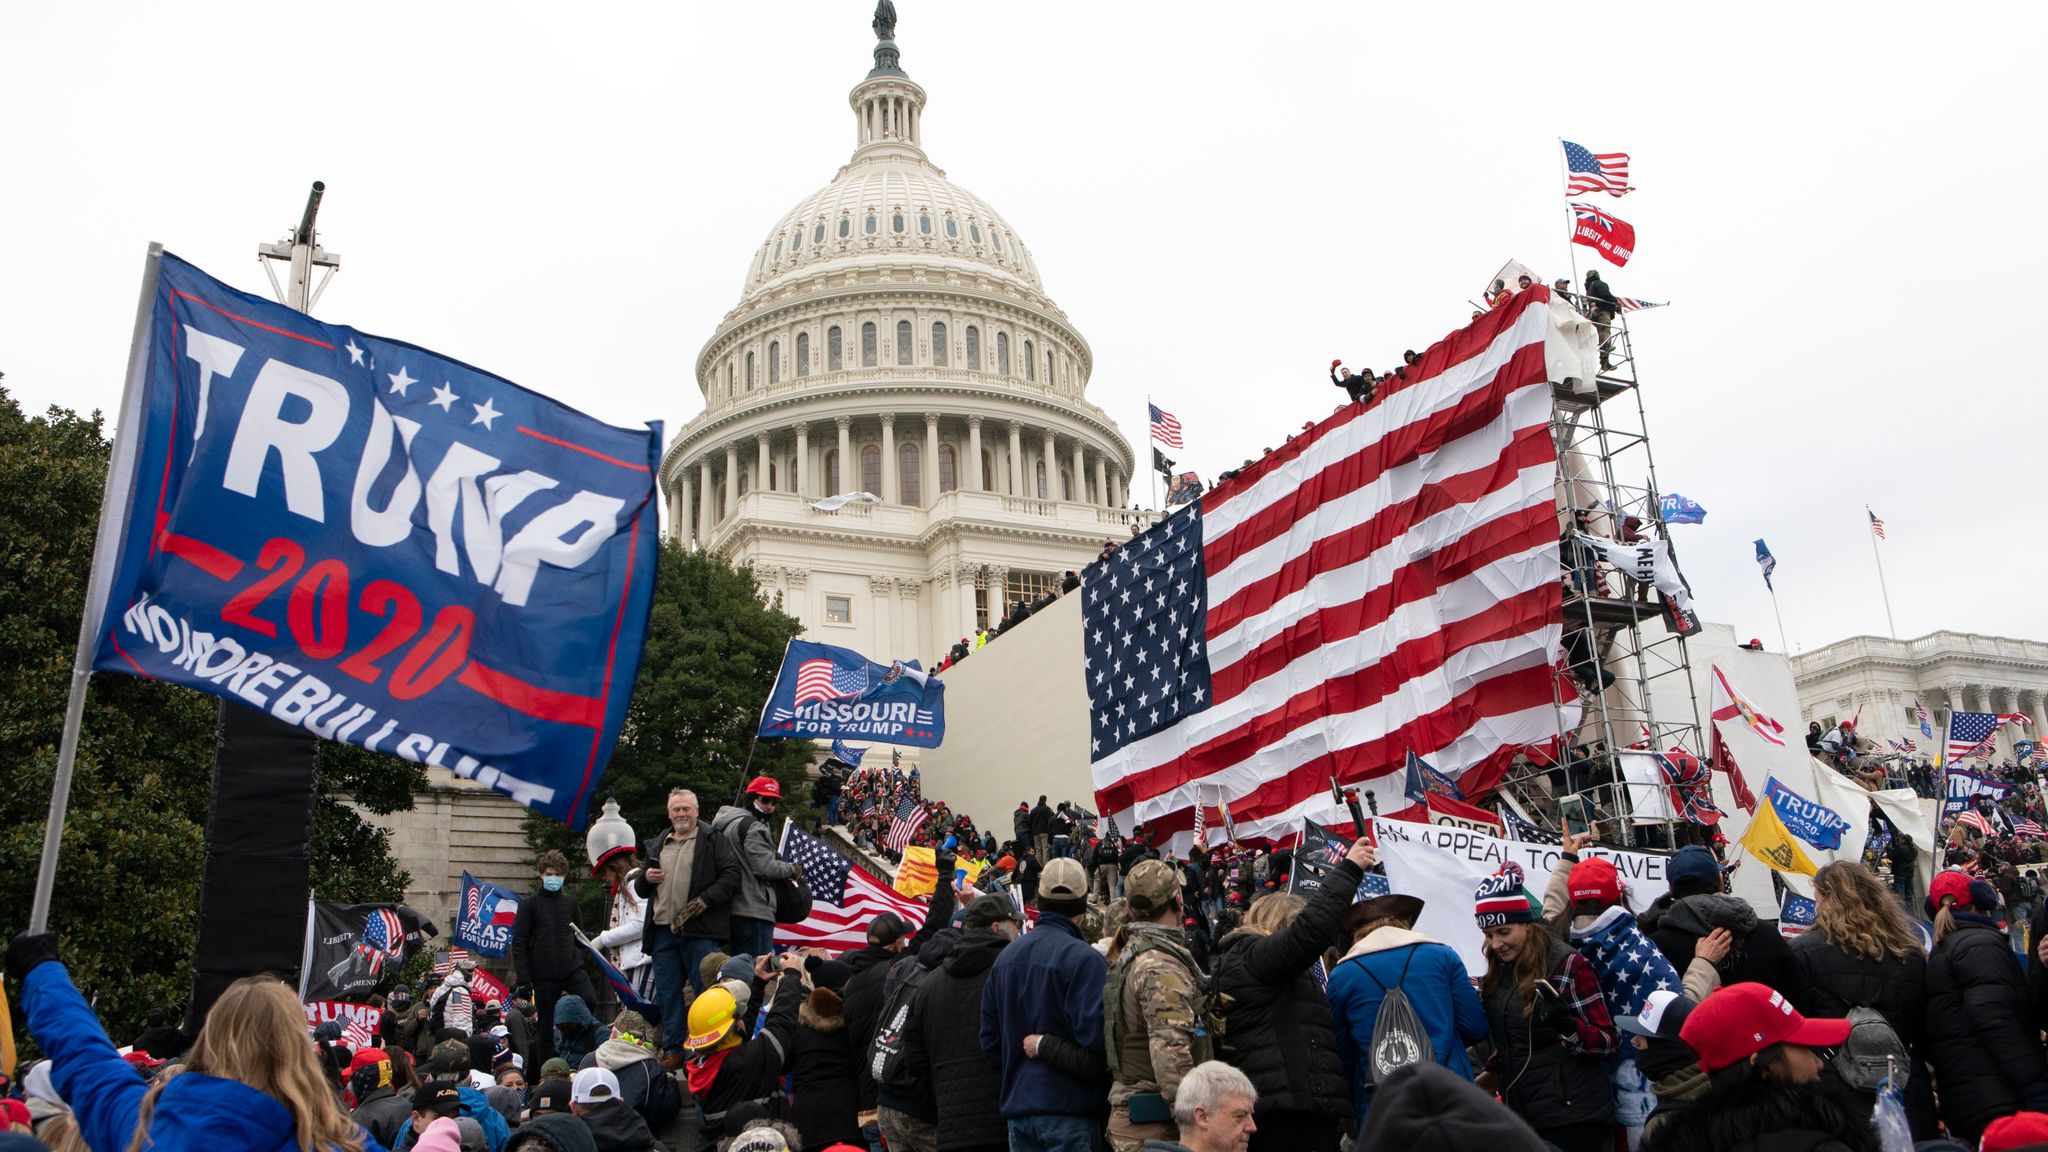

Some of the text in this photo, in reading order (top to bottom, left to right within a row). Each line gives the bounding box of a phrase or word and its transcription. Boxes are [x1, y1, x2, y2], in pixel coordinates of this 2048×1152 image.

[1600, 239, 1612, 251] AND
[1612, 244, 1632, 261] UNIO
[183, 322, 626, 607] TRUMP
[221, 537, 476, 700] 2020
[123, 591, 180, 653] NO
[172, 617, 302, 709] MORE
[794, 700, 917, 724] MISSOURI
[795, 720, 904, 736] FOR TRUMP
[1775, 789, 1844, 830] TRUMP
[1375, 822, 1410, 843] AN
[1525, 849, 1561, 873] TO
[1475, 867, 1521, 898] RUMP
[1793, 905, 1806, 919] 2
[323, 932, 354, 945] LIBERTY
[303, 1001, 380, 1032] RUMP
